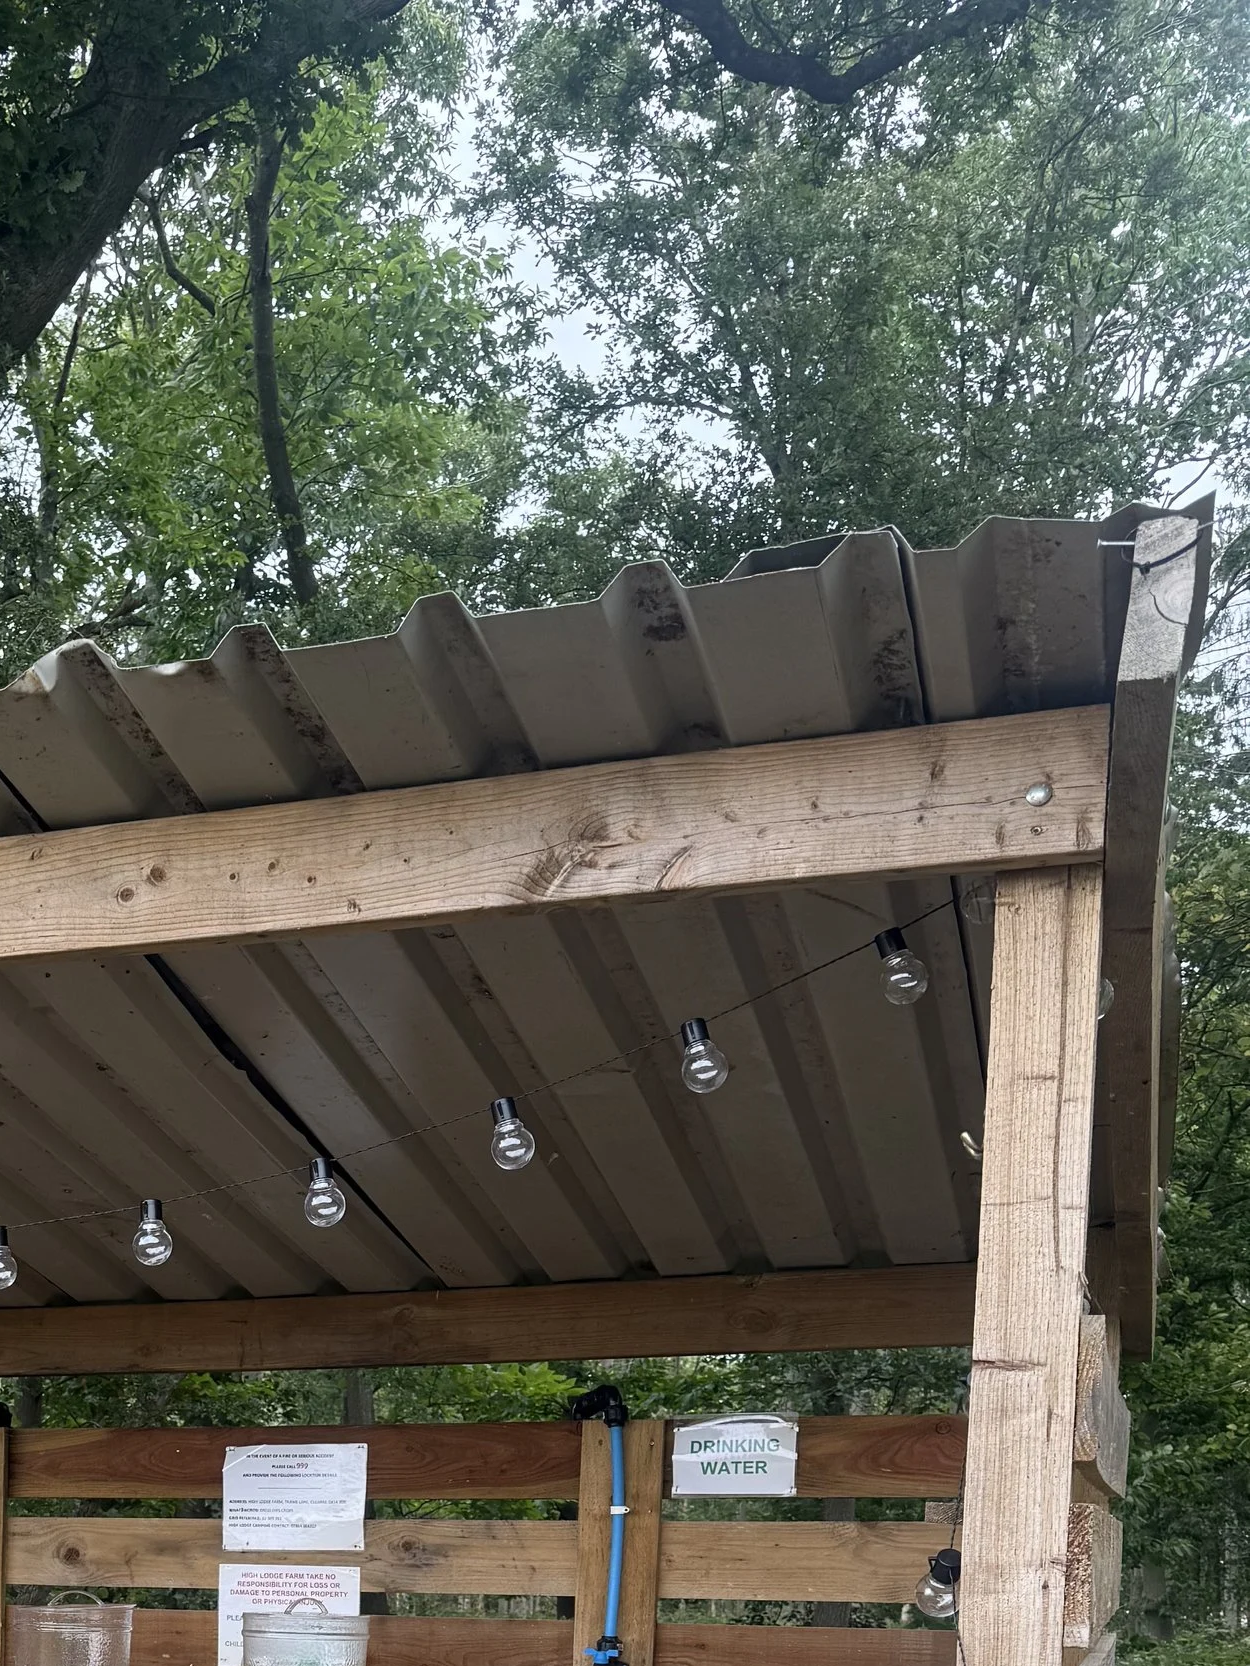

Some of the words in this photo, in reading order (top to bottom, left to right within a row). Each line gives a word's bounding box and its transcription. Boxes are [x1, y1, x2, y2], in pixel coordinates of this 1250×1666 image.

[690, 1438, 780, 1454] DRINKING
[296, 1462, 309, 1470] 999
[701, 1460, 768, 1475] WATER
[260, 1572, 284, 1580] LODGE
